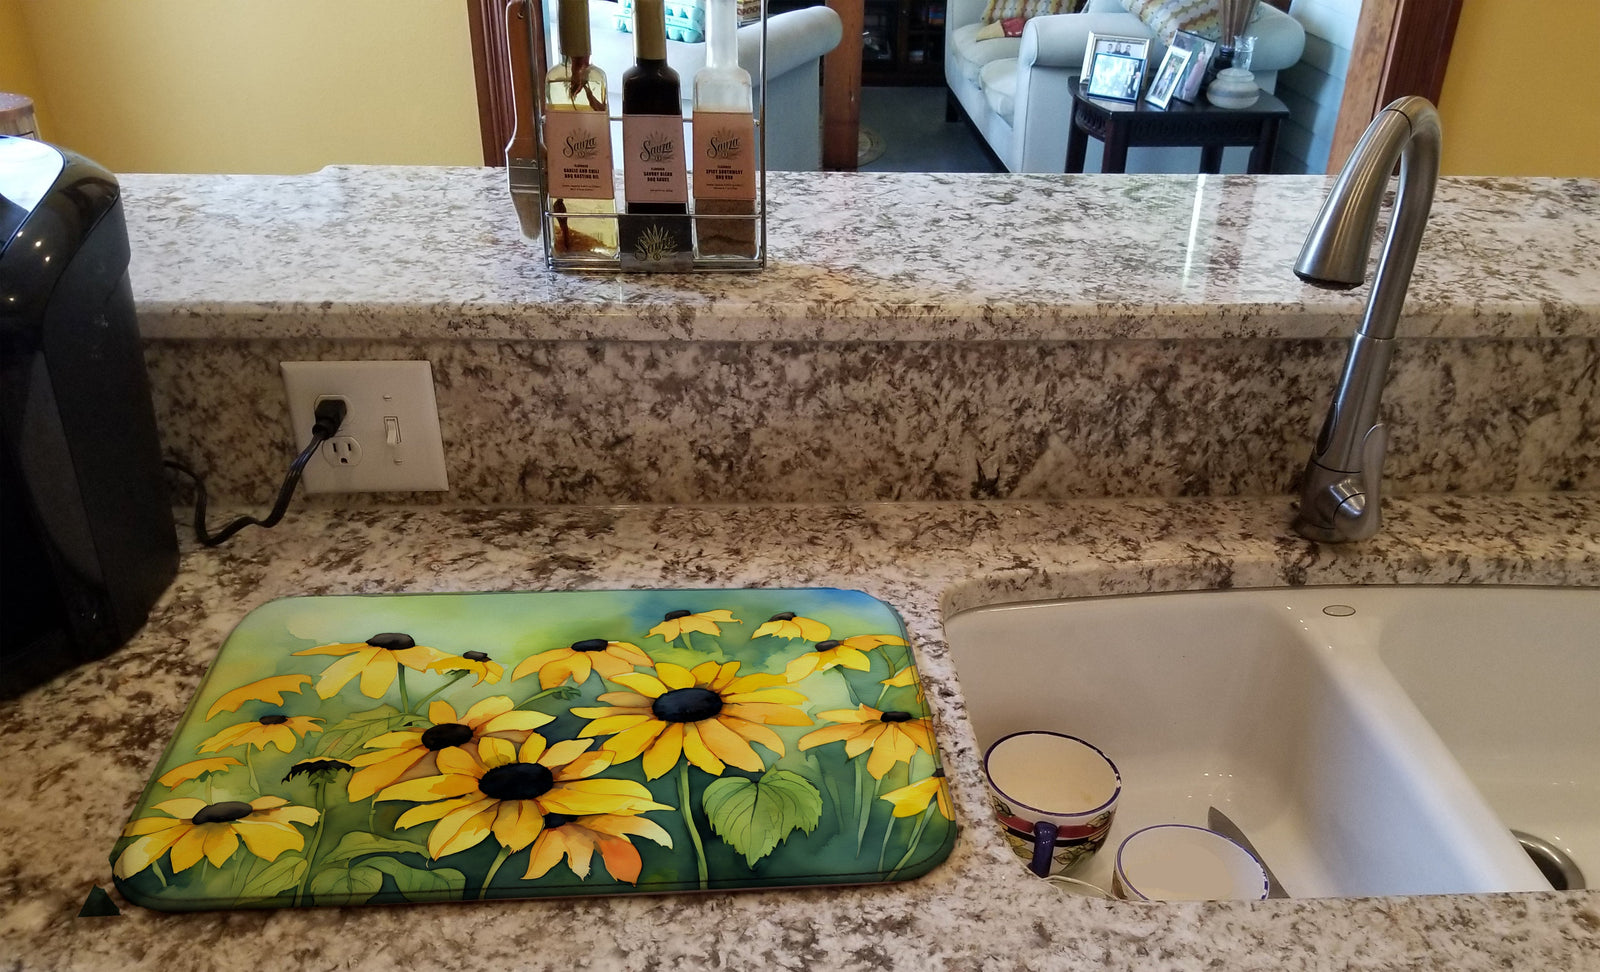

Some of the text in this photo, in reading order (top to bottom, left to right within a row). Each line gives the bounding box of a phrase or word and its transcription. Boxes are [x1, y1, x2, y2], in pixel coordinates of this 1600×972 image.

[562, 136, 598, 158] Sauza
[640, 140, 674, 161] Sauza
[706, 137, 740, 158] Sauza
